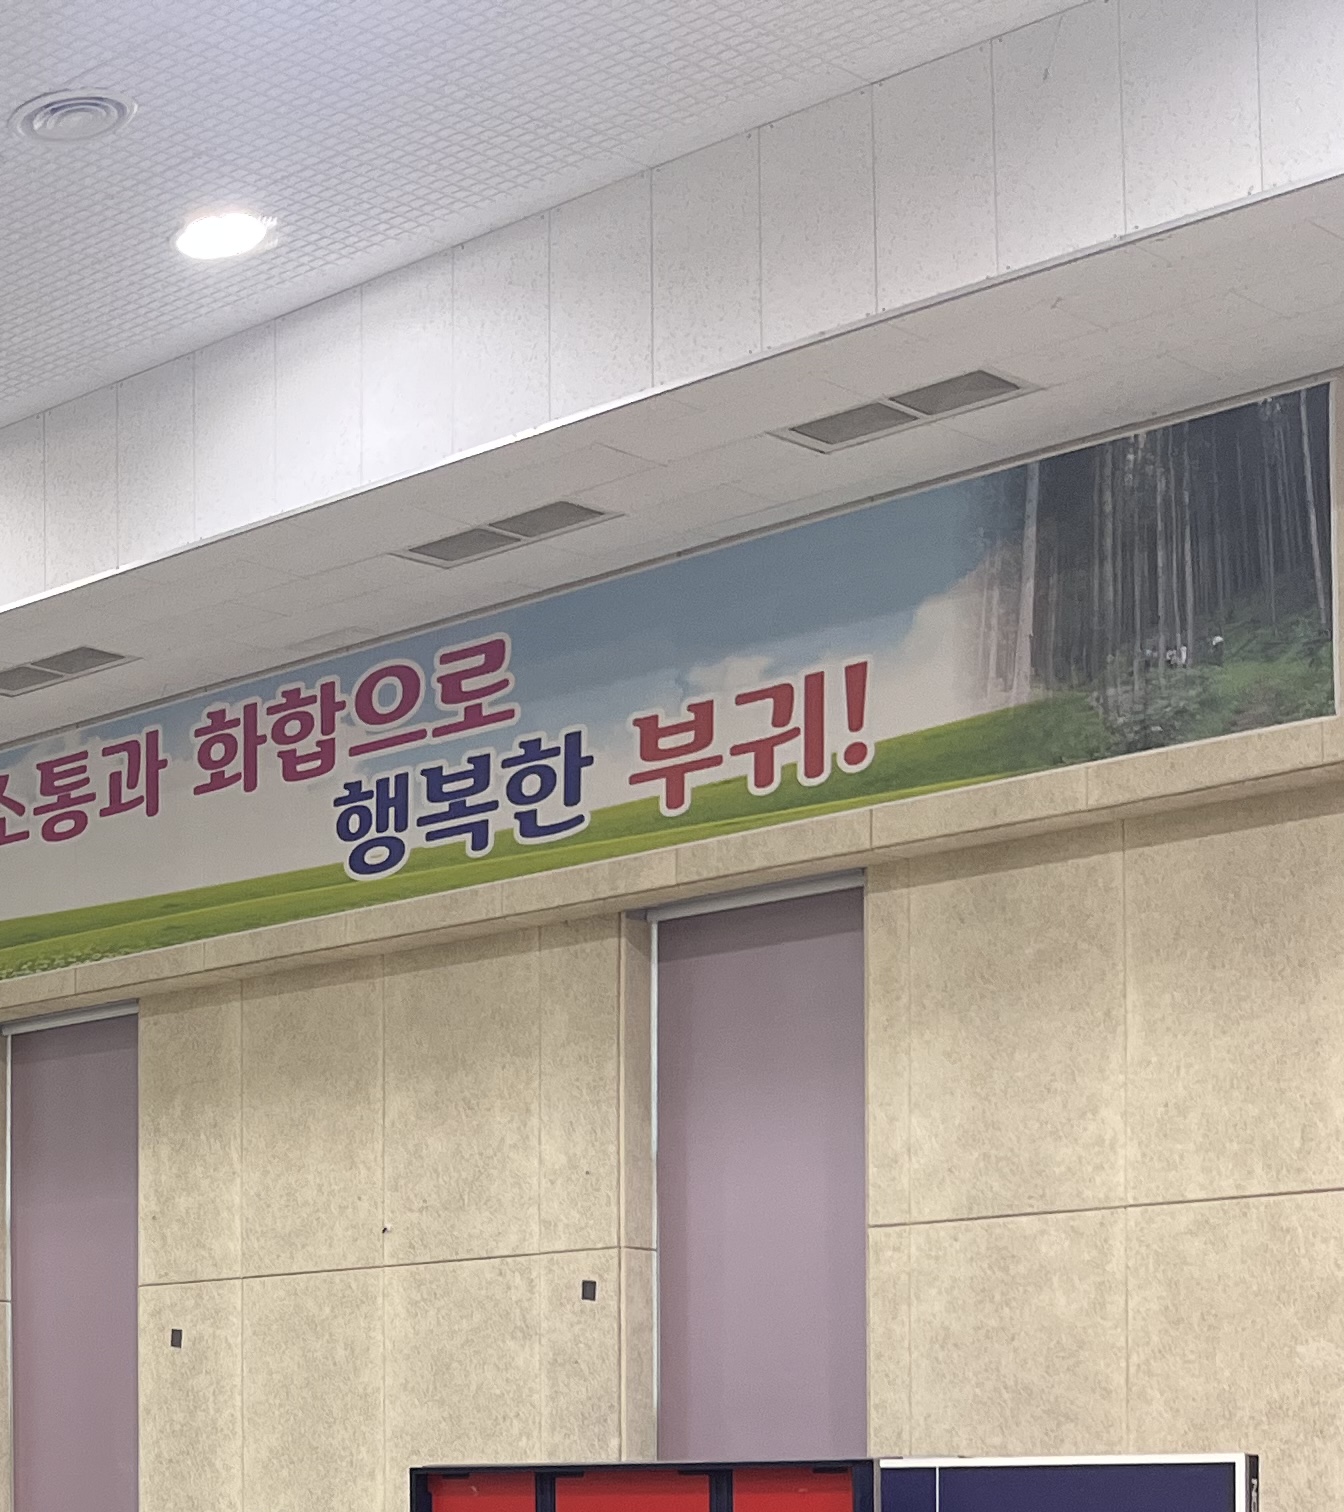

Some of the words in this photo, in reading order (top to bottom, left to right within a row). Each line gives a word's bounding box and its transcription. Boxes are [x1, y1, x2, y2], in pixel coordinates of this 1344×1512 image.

[192, 638, 515, 797] 화합으로
[333, 730, 594, 876] 행복한
[628, 660, 870, 811] 부귀!
